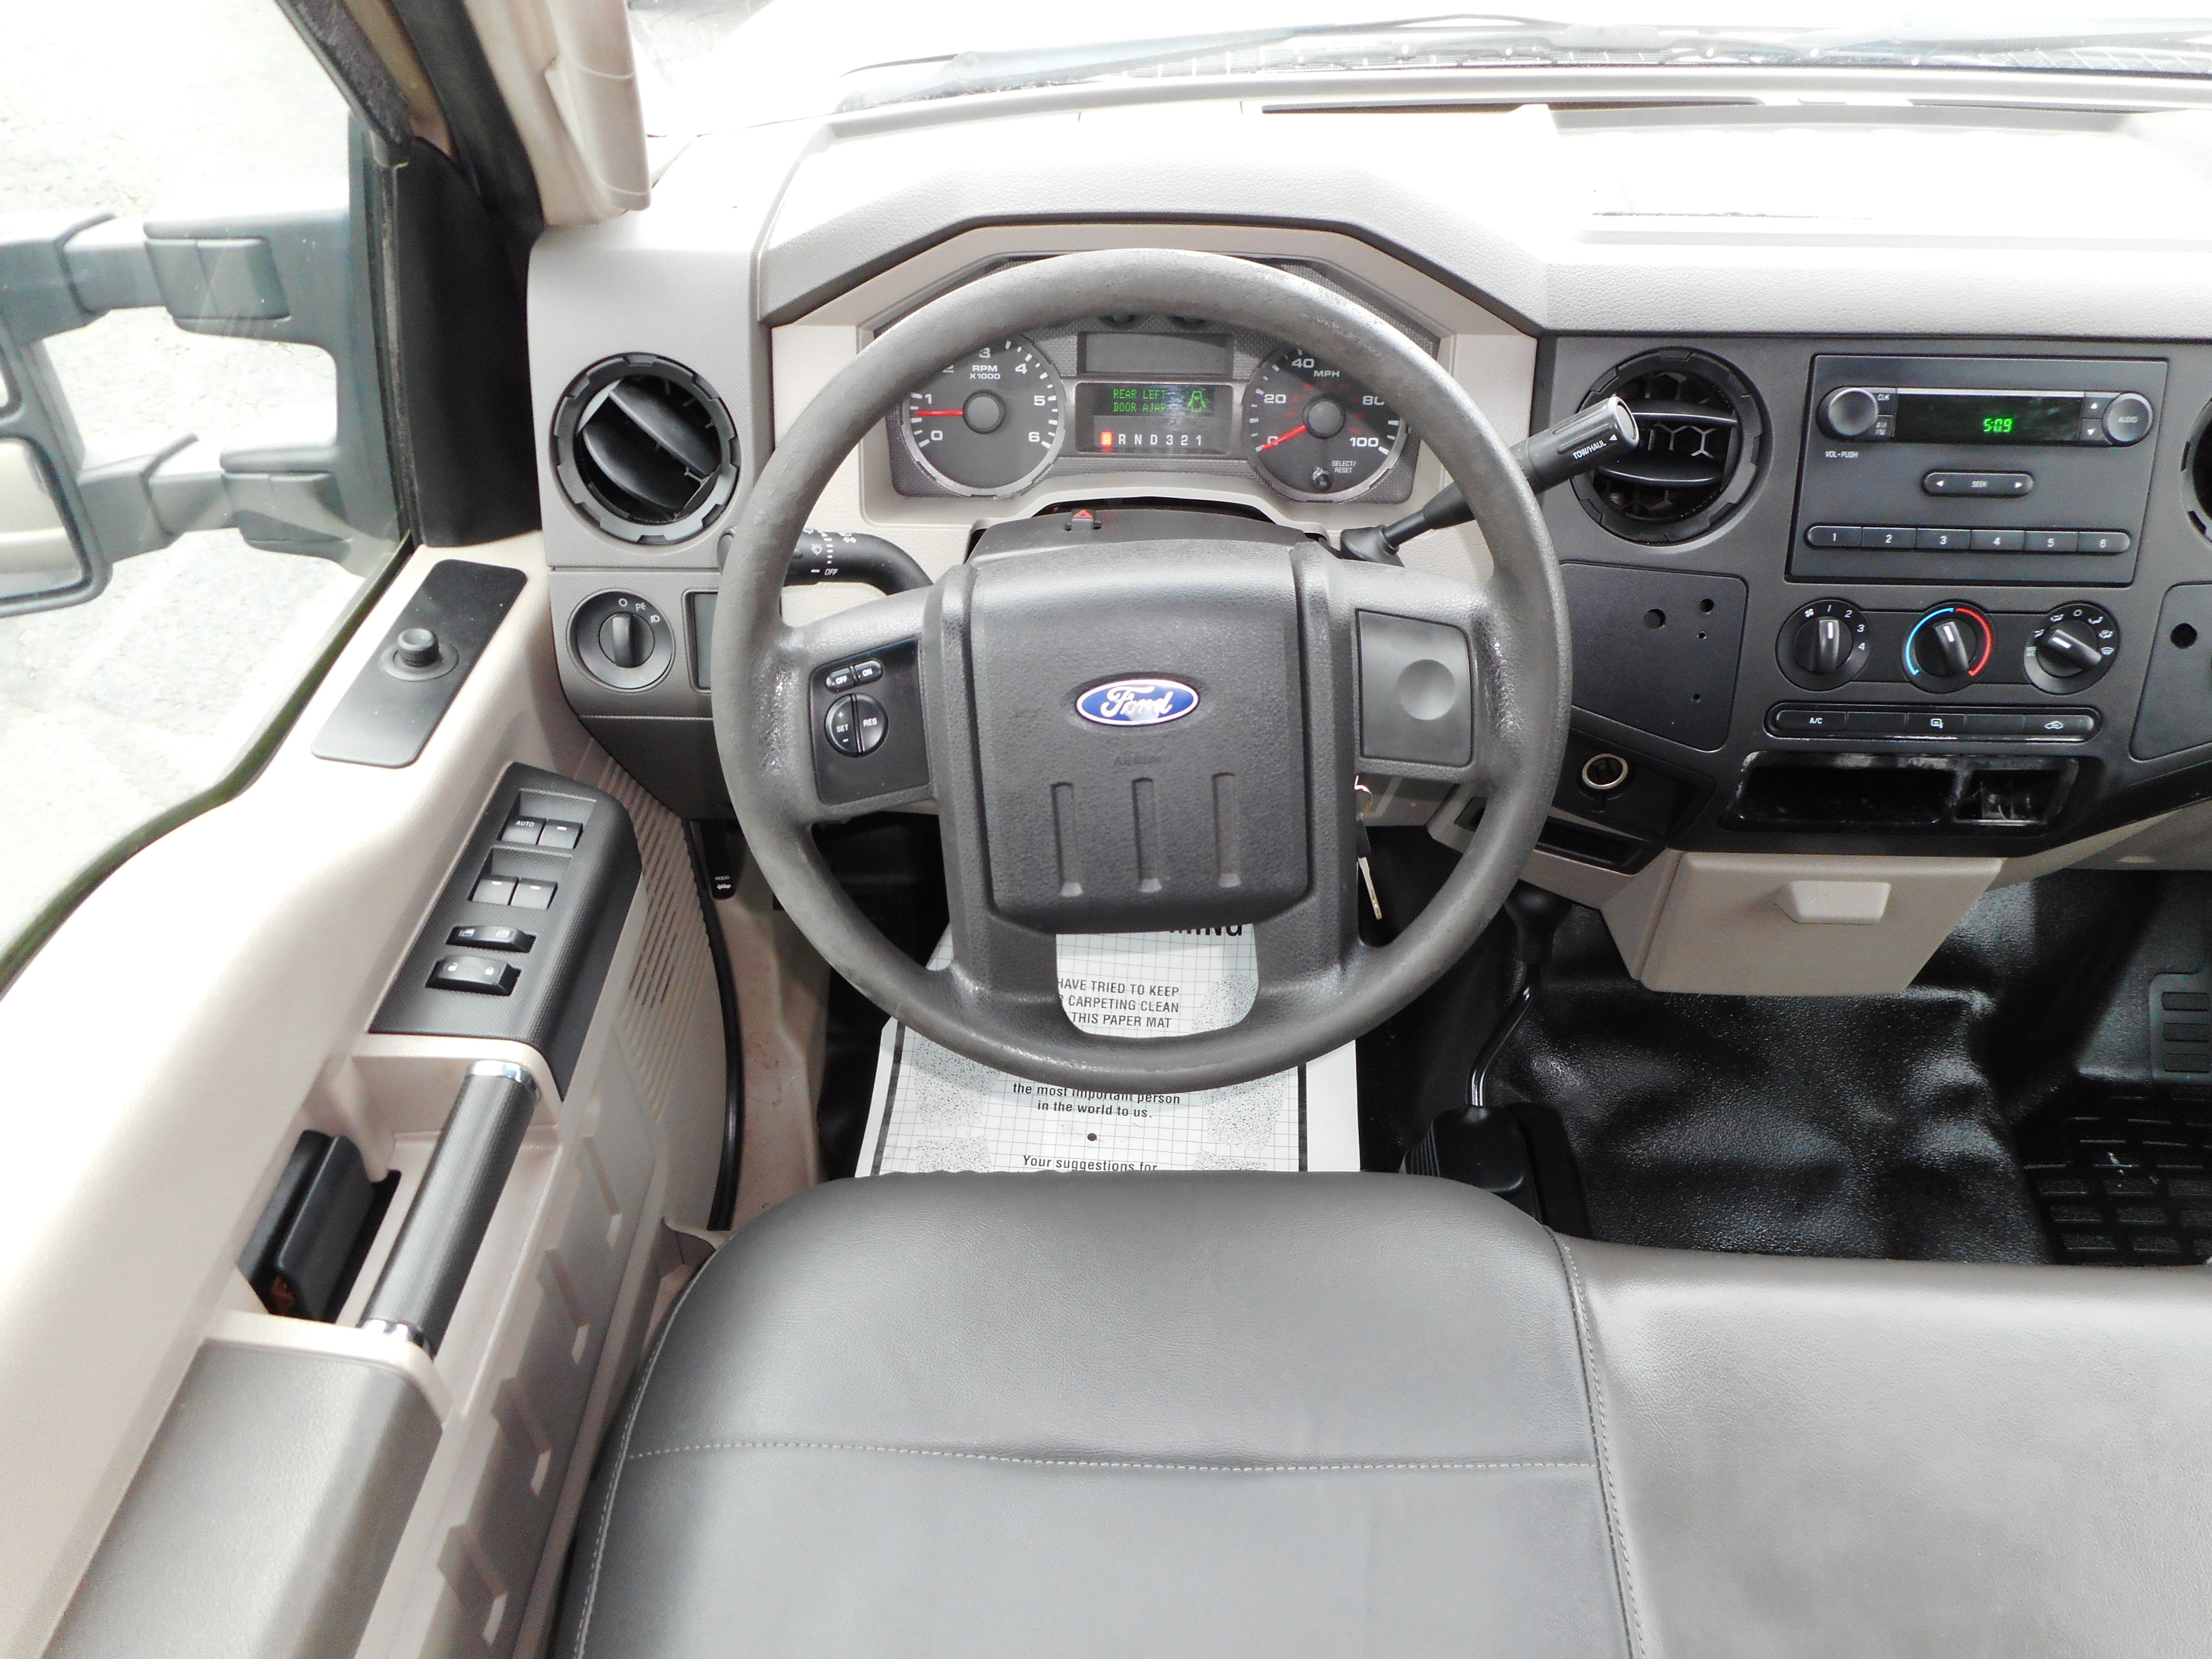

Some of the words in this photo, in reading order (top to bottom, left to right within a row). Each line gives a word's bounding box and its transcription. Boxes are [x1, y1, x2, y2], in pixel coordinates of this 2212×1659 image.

[979, 347, 991, 358] 3
[1292, 359, 1315, 368] 40
[1015, 364, 1027, 374] 4
[925, 394, 932, 404] 1
[1113, 389, 1137, 399] REAR
[1143, 389, 1167, 399] LEFT
[1264, 394, 1286, 404] 20
[1034, 395, 1045, 406] 5
[1113, 403, 1136, 412] DOOR
[1143, 403, 1166, 412] AJAR
[931, 431, 943, 441] 0
[1029, 432, 1039, 442] 6
[1118, 434, 1126, 444] R
[1135, 434, 1142, 444] N
[1151, 434, 1158, 445] D
[1166, 435, 1173, 445] 3
[1181, 435, 1188, 445] 2
[1196, 435, 1201, 445] 1
[1350, 438, 1379, 447] 100
[1573, 440, 1607, 459] TOW/HAUL
[1832, 533, 1836, 541] 1
[1886, 535, 1892, 543] 2
[1940, 536, 1947, 545] 3
[1993, 537, 2000, 546] 4
[2048, 538, 2054, 547] 5
[2100, 539, 2106, 548] 6
[862, 668, 872, 677] ON
[836, 675, 848, 685] OFF
[1100, 686, 1173, 717] Ford
[863, 717, 877, 726] RES
[837, 724, 848, 732] SET
[1091, 981, 1125, 994] TRIED
[1131, 984, 1144, 995] TO
[1149, 985, 1179, 997] KEEP
[1068, 995, 1136, 1011] CARPETING
[1141, 1001, 1179, 1013] CLEAN
[1072, 1012, 1098, 1024] THIS
[1103, 1015, 1141, 1027] PAPER
[1146, 1017, 1171, 1028] MAT
[1013, 1083, 1032, 1094] the
[1037, 1087, 1067, 1096] most
[1137, 1094, 1180, 1104] person
[1038, 1100, 1048, 1110] in
[1054, 1101, 1073, 1112] the
[1078, 1104, 1112, 1115] world
[1117, 1106, 1128, 1116] to
[1133, 1109, 1152, 1118] us.
[1023, 1155, 1051, 1167] Your
[1056, 1159, 1135, 1171] suggestions
